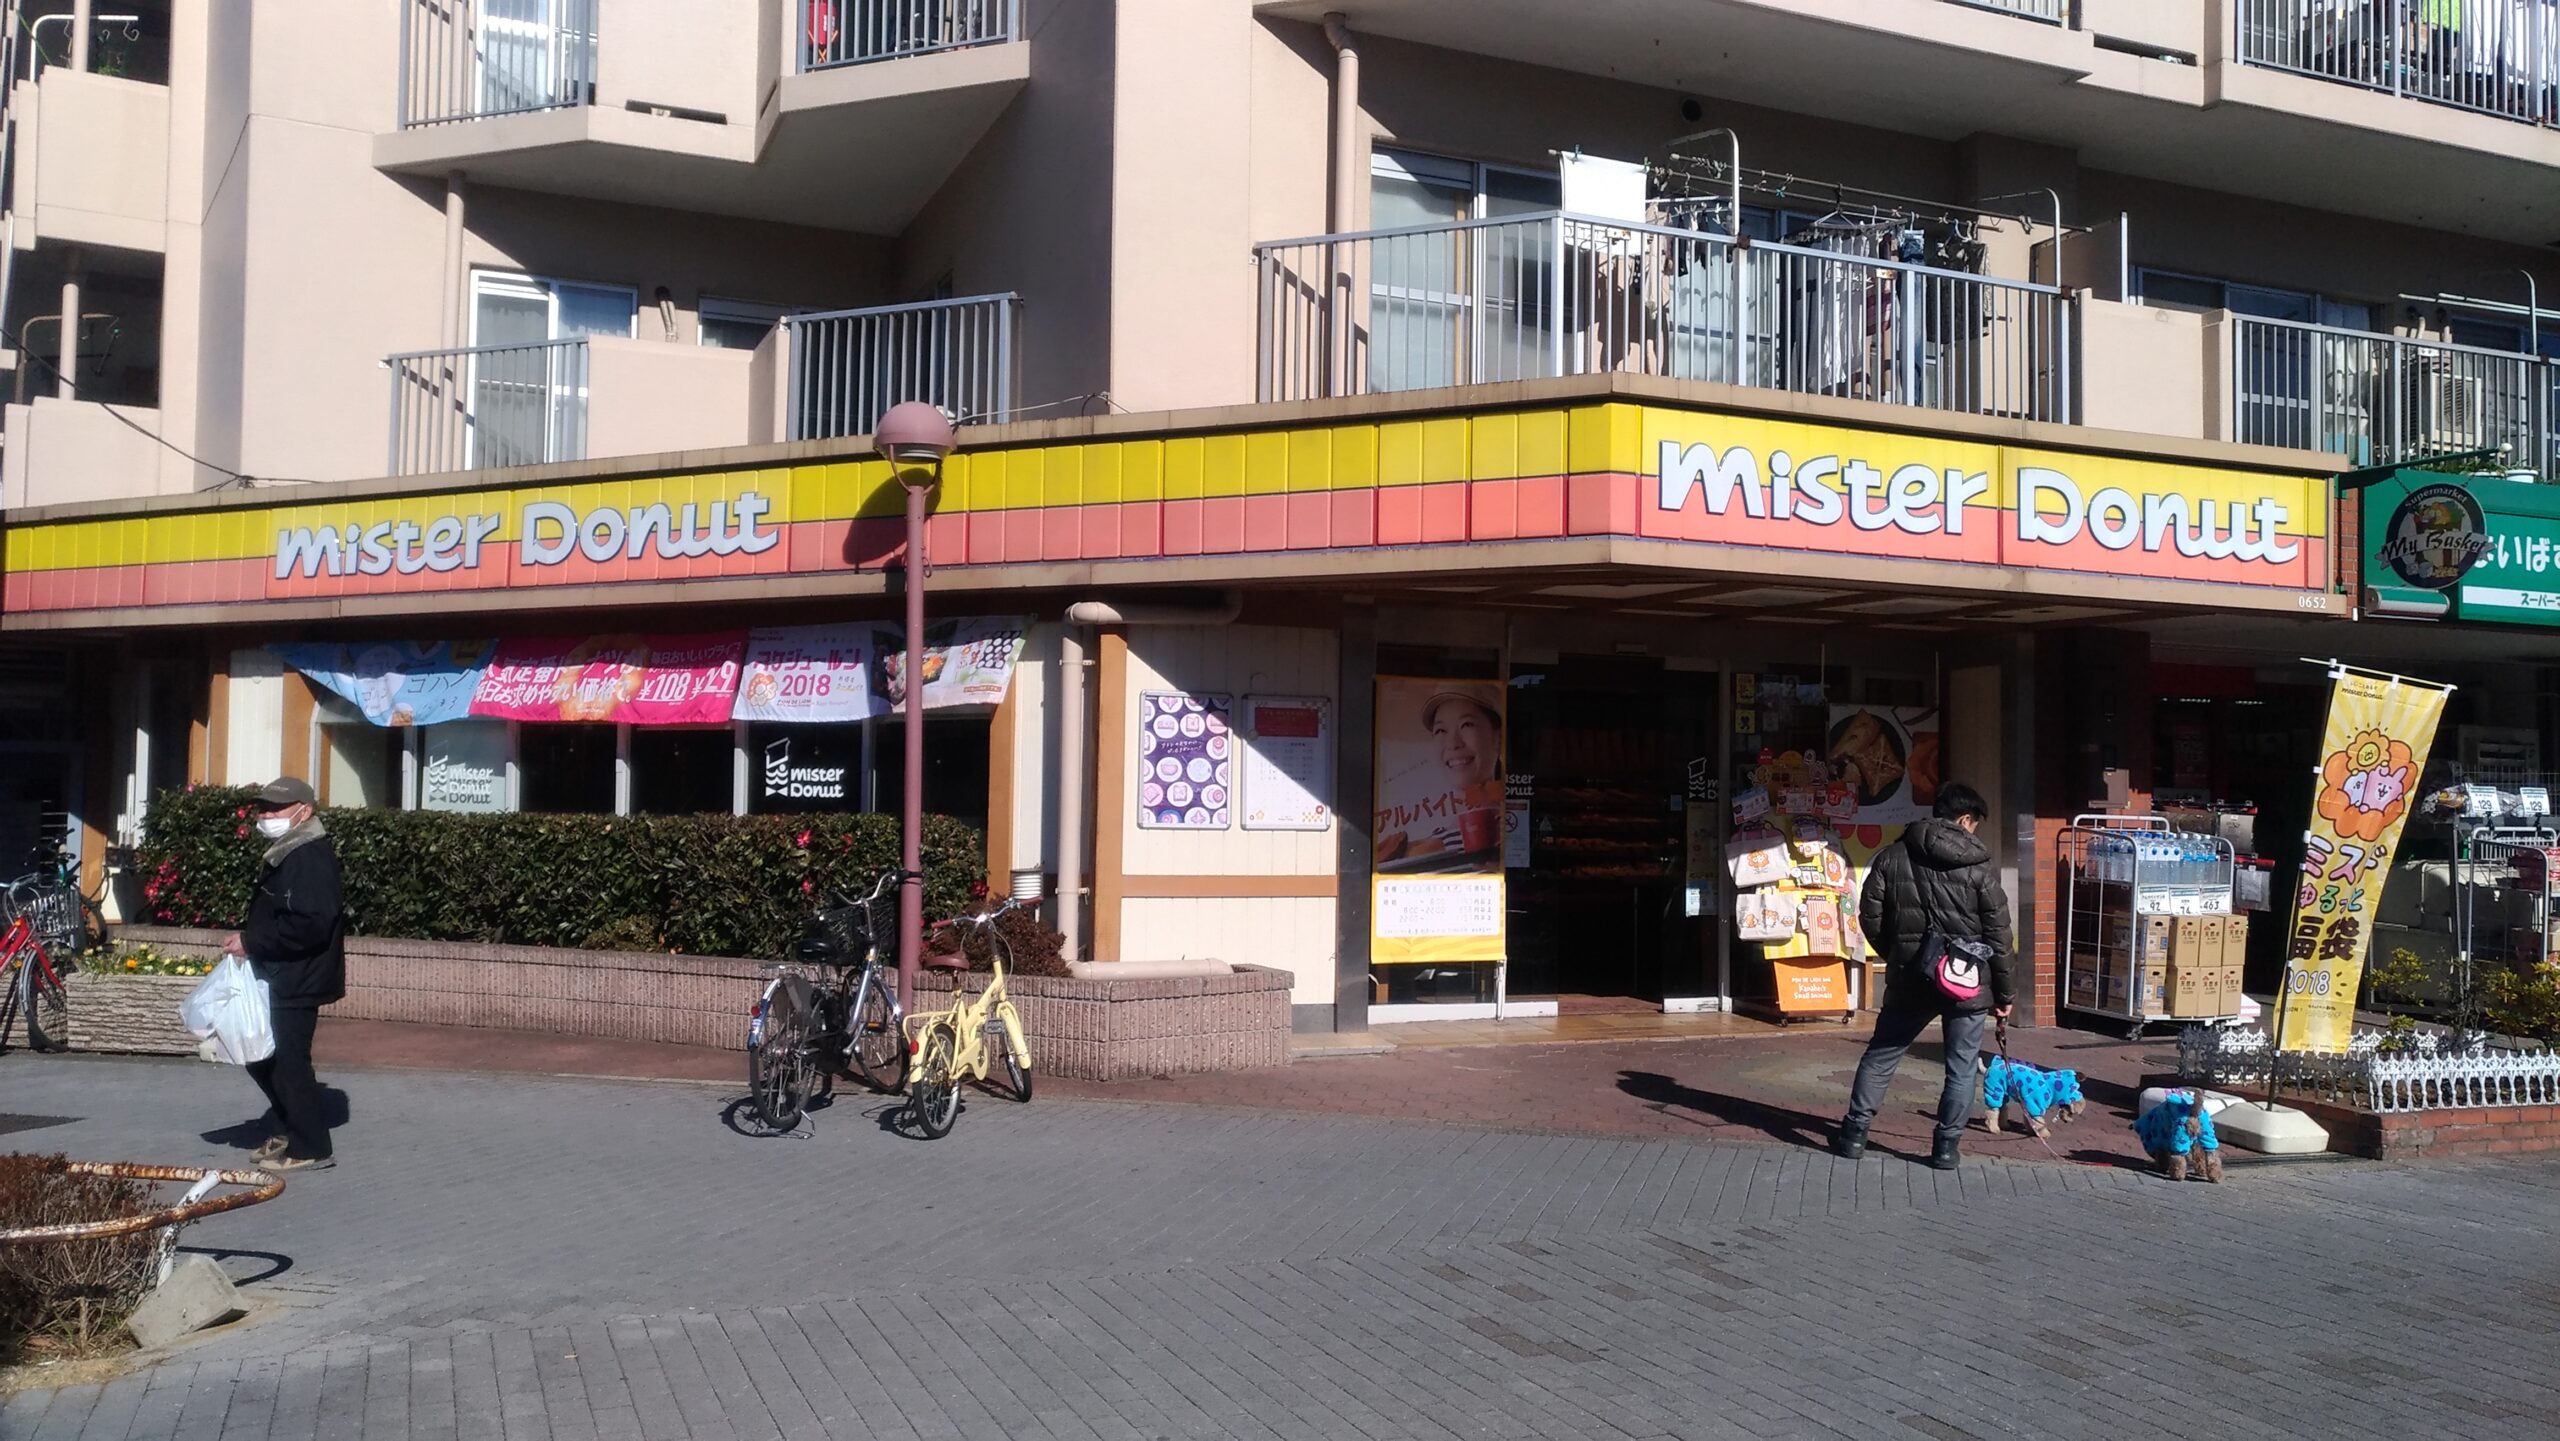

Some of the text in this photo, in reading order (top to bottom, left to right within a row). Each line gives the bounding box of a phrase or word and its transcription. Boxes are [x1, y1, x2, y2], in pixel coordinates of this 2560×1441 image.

[2404, 486, 2469, 508] Supermarket
[2016, 466, 2298, 564] Donut
[520, 491, 779, 566] Donut
[2382, 532, 2487, 559] My Basket
[2298, 596, 2327, 609] 0652
[780, 674, 830, 697] 2018
[1505, 774, 1535, 784] ister
[790, 783, 844, 798] Donut
[1505, 786, 1535, 796] onut
[1375, 791, 1481, 834] アルバイト
[2478, 800, 2492, 810] 129
[2529, 801, 2543, 811] 129
